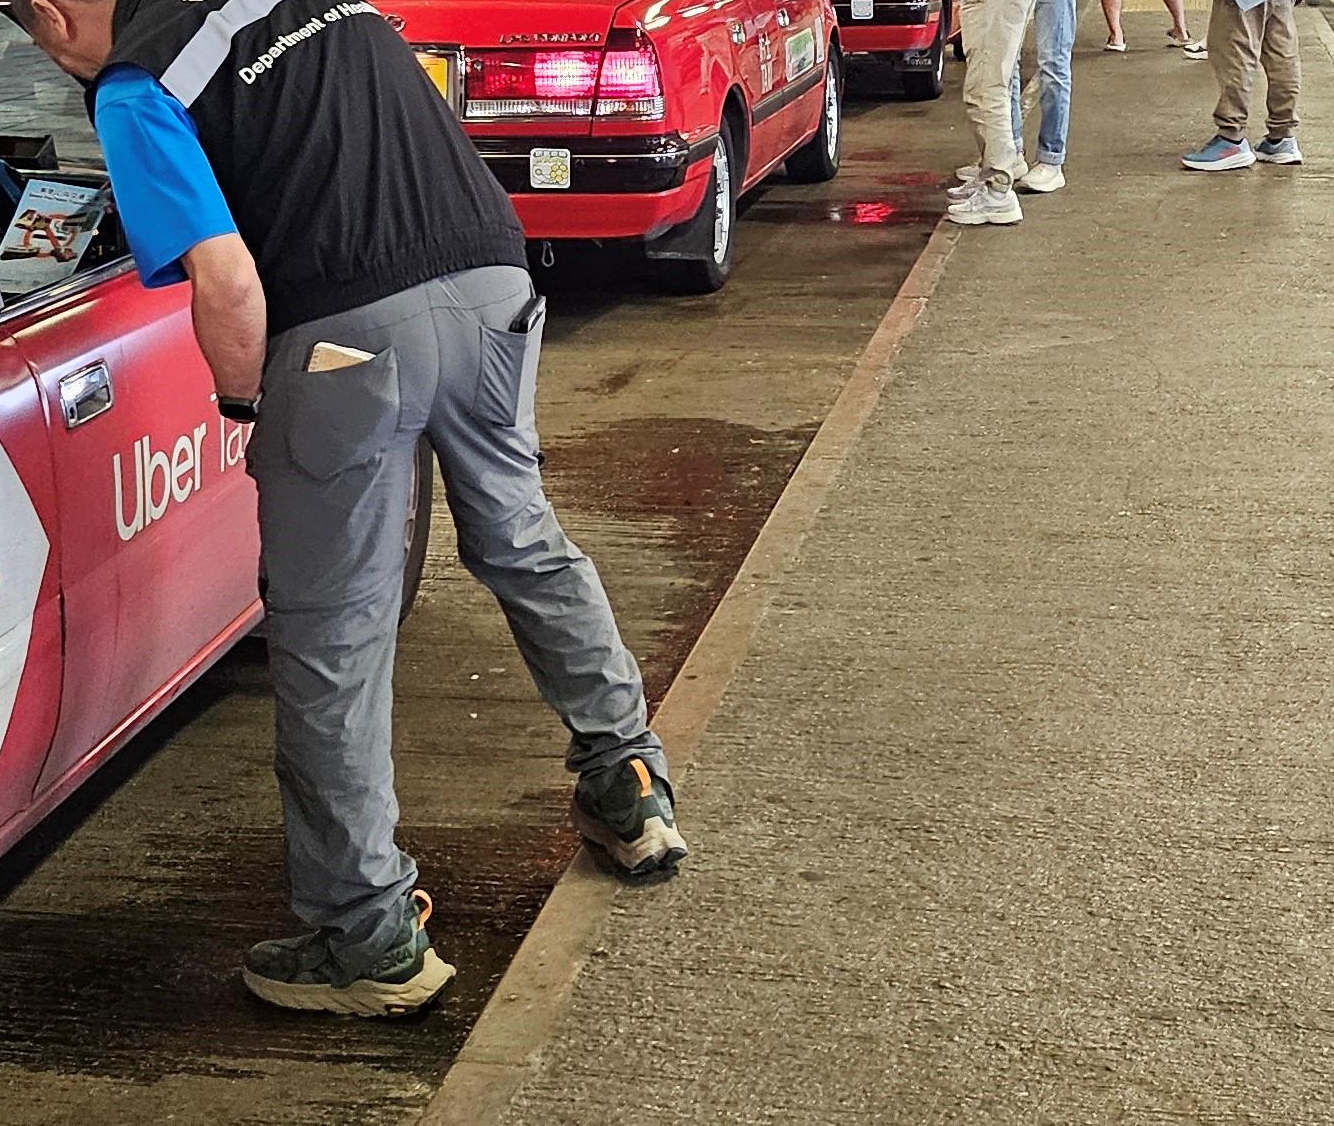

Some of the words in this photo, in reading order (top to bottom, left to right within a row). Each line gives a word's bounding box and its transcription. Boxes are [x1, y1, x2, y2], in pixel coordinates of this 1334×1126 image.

[238, 17, 327, 85] Department
[324, 5, 344, 22] of
[113, 422, 207, 542] Uber
